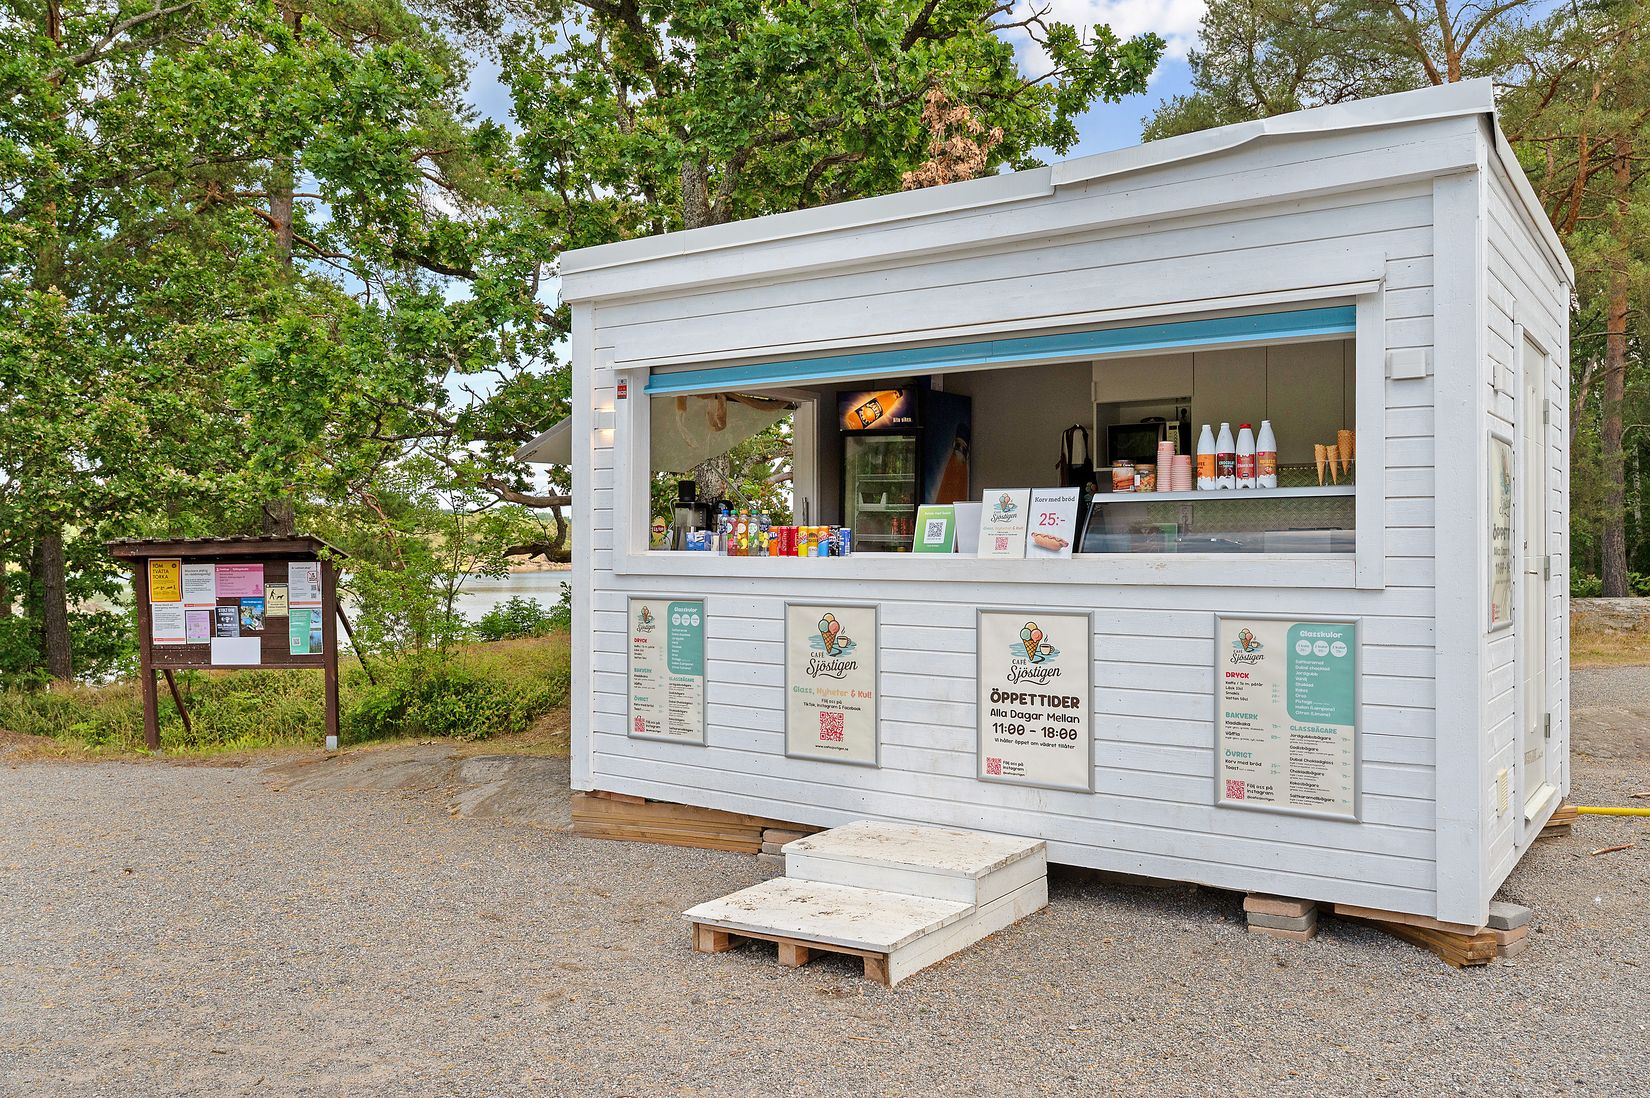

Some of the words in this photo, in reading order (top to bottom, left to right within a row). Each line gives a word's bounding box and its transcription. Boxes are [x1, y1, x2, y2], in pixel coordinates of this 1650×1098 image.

[1039, 513, 1065, 526] 25:-
[1300, 630, 1343, 638] Glasskulor
[1230, 652, 1264, 664] Sjöstigen
[806, 658, 858, 678] Sjöstigen
[1007, 665, 1061, 684] Sjöstigen
[816, 688, 848, 697] Nyheter
[990, 688, 1080, 709] ÖPPETTIDER
[990, 708, 1007, 717] Alla
[1010, 710, 1044, 722] Dagar
[1047, 713, 1080, 723] Mellan
[1226, 712, 1258, 720] BAKVERK
[992, 722, 1025, 736] 11:00
[1041, 727, 1078, 740] 18:00
[1226, 749, 1252, 758] ÖVRIGT
